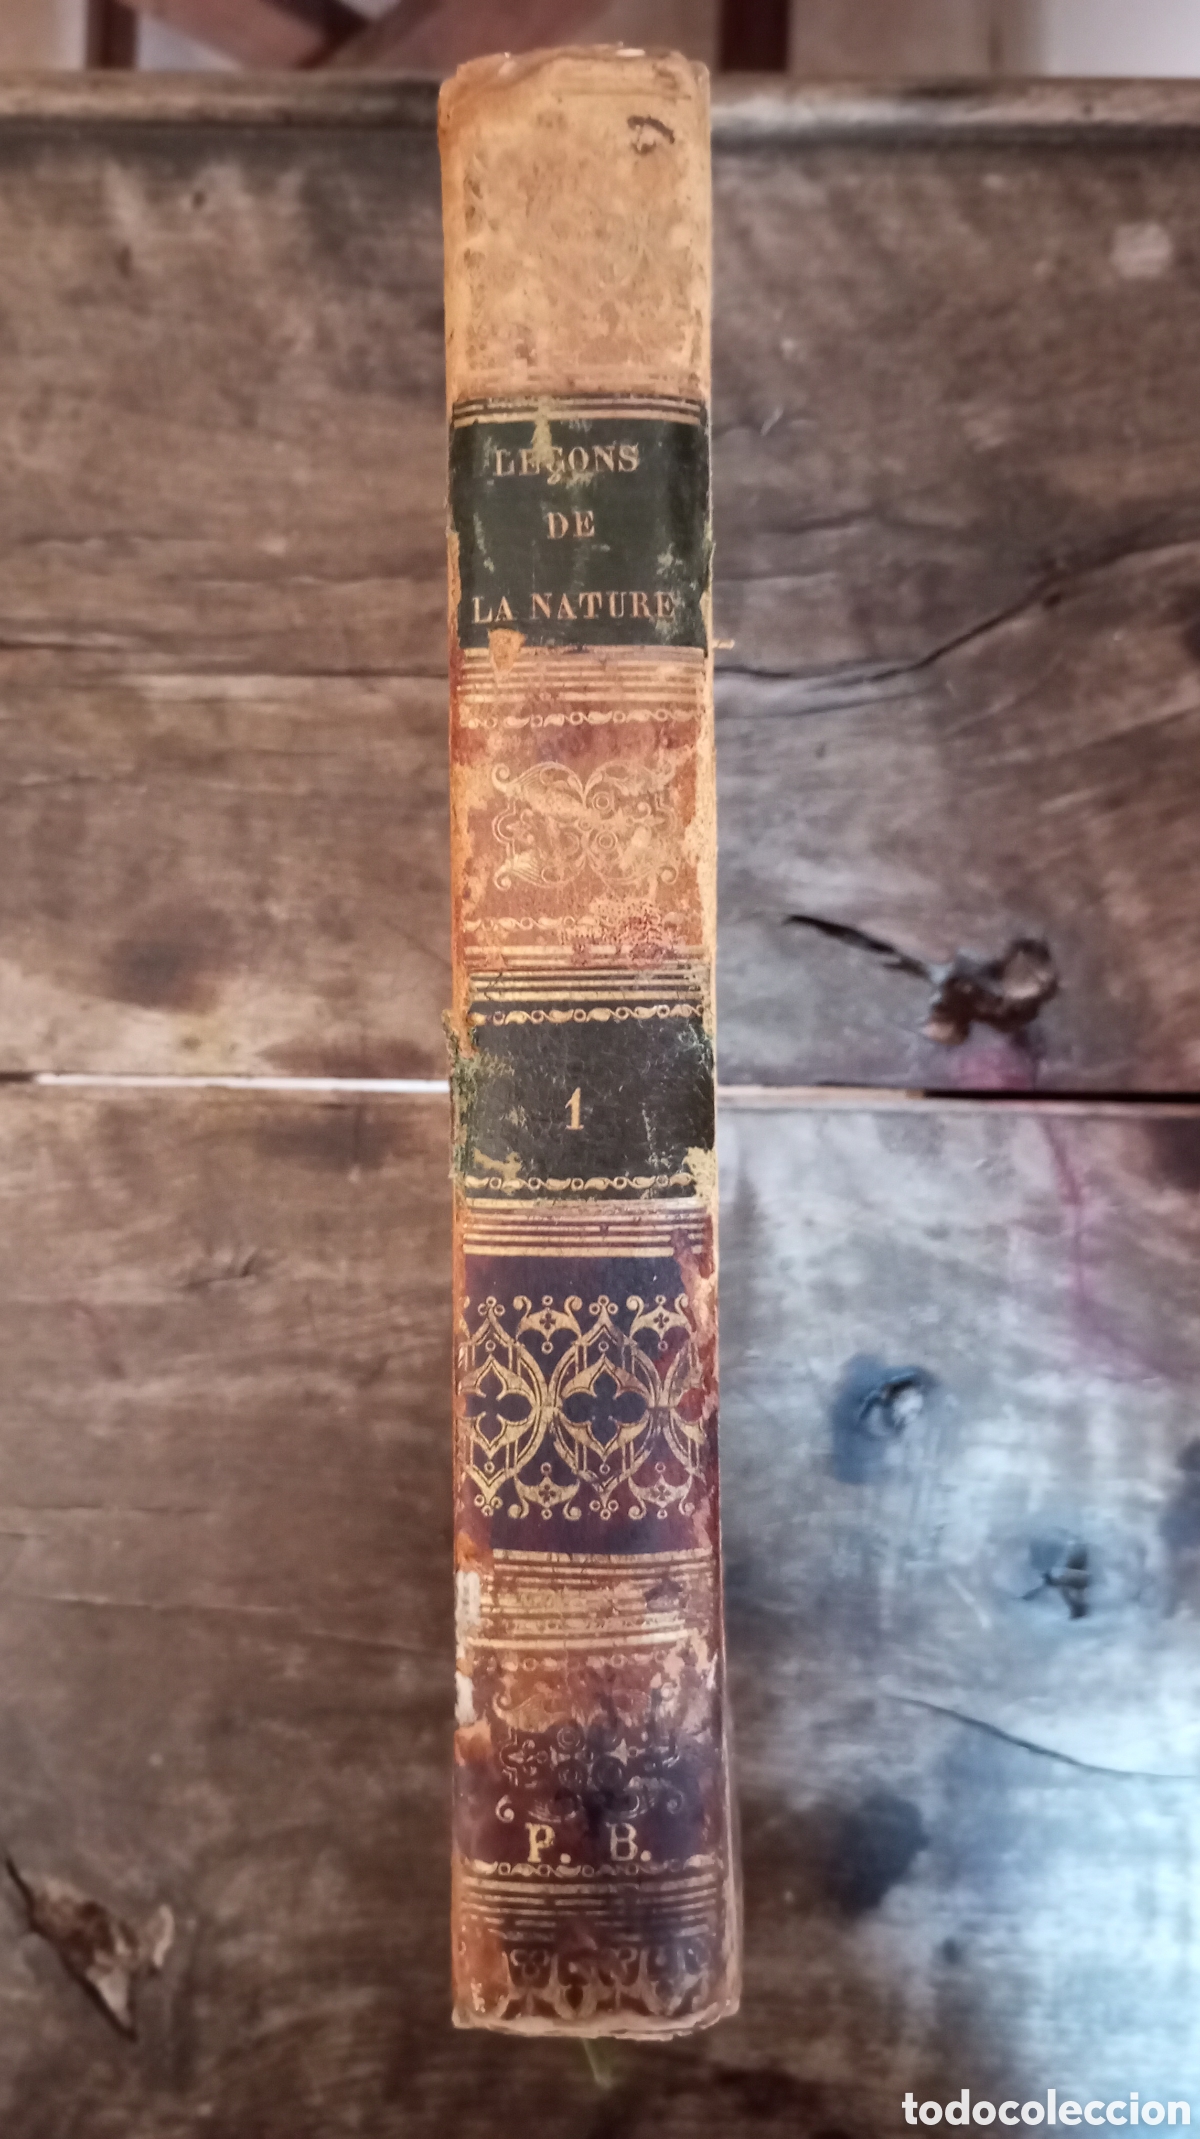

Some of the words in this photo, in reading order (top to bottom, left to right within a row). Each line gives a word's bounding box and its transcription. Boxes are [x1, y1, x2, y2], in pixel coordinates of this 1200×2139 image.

[547, 511, 595, 539] DE
[472, 595, 517, 624] LA
[531, 591, 676, 621] NATURE
[565, 1087, 584, 1130] 1
[525, 1822, 571, 1863] P.
[606, 1822, 651, 1862] B.
